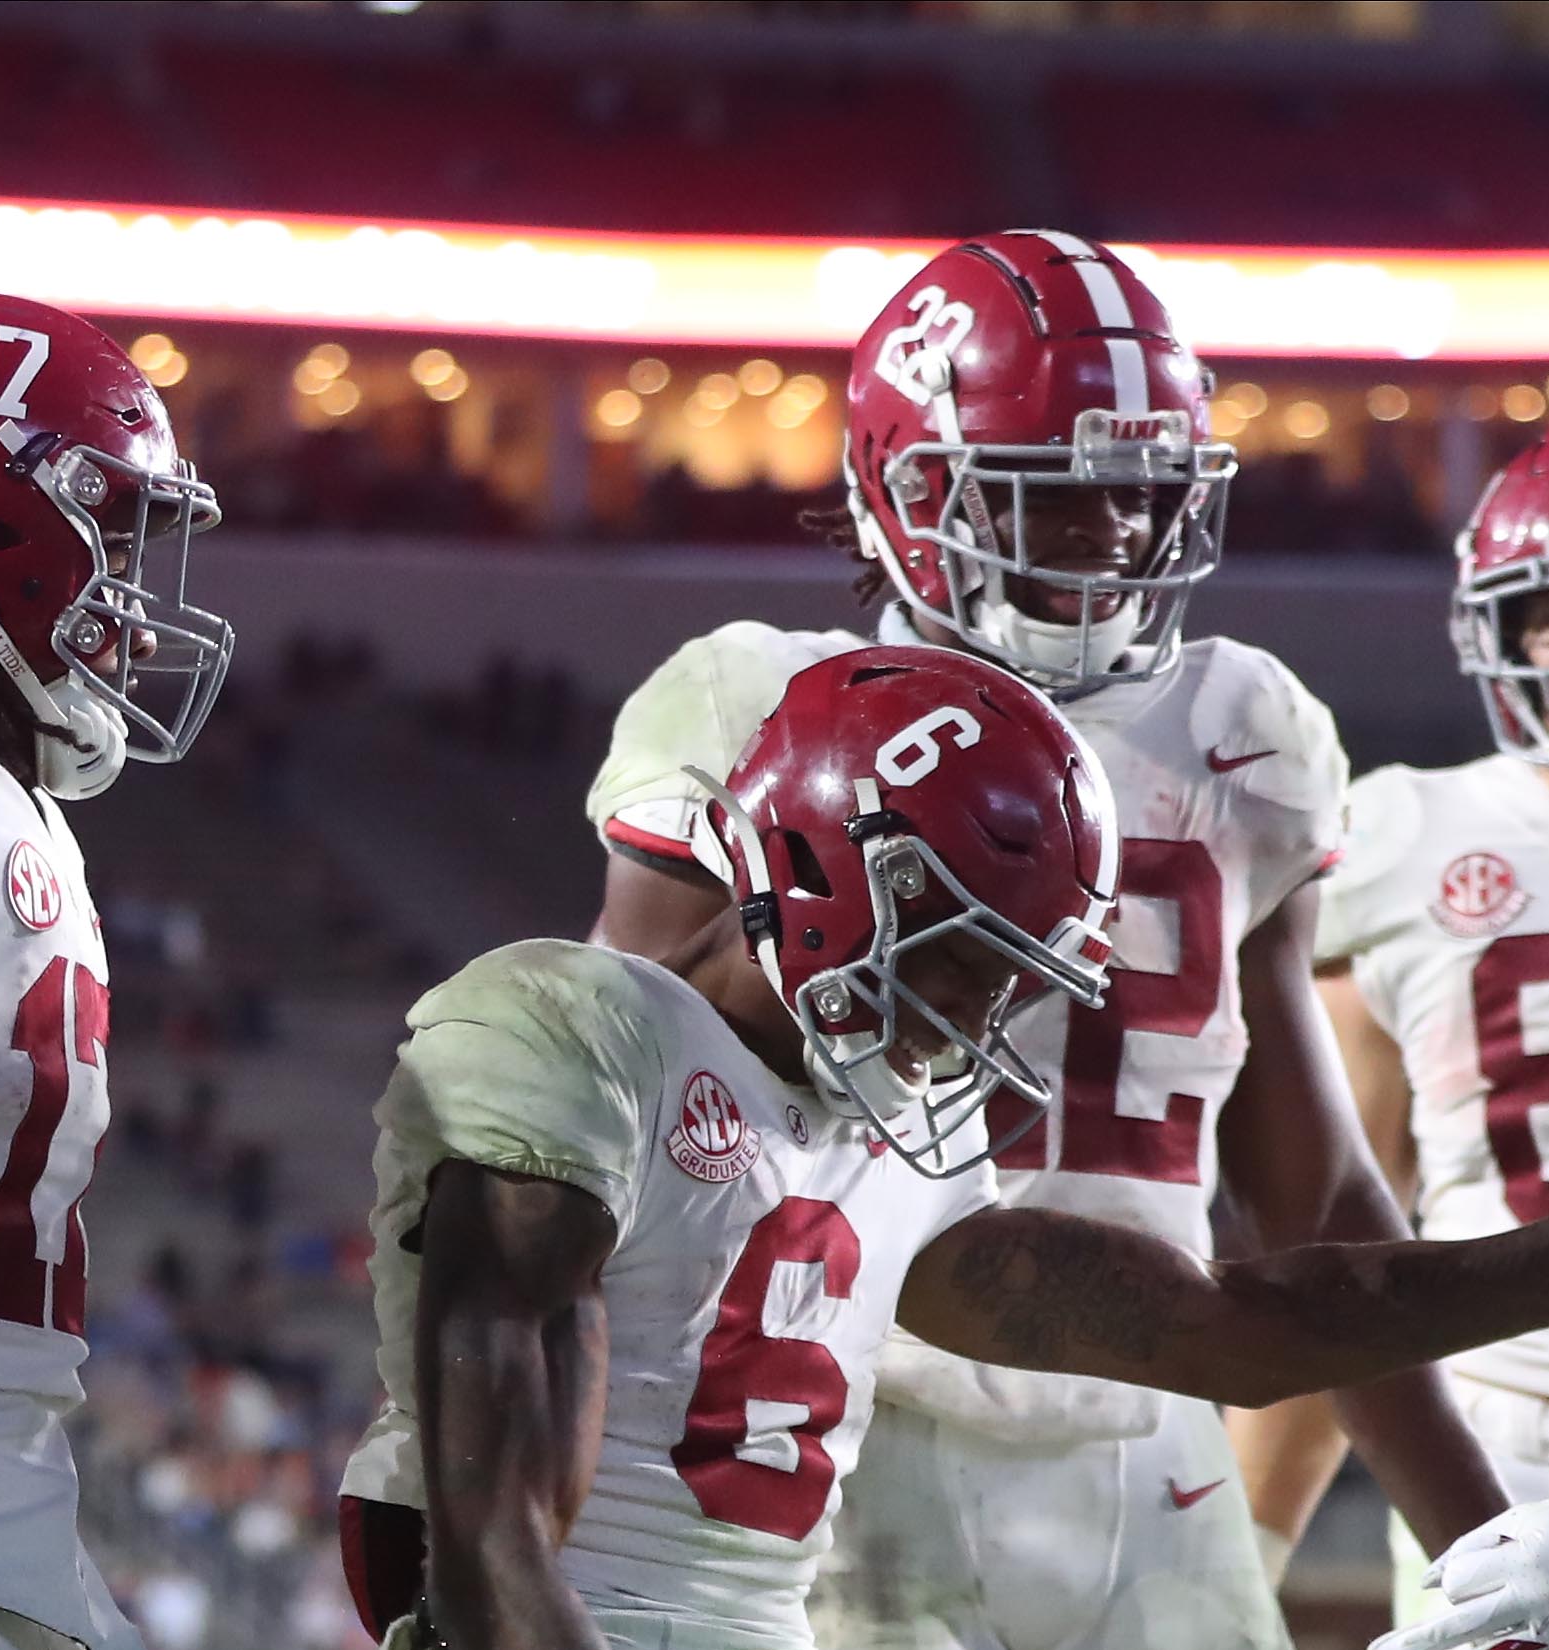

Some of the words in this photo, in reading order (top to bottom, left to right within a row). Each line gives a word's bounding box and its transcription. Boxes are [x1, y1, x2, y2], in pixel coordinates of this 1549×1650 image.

[875, 706, 981, 787] 6
[11, 845, 60, 924] SEC
[684, 1074, 741, 1151] SEC
[677, 1147, 755, 1180] GRADUATE
[669, 1195, 862, 1542] 6
